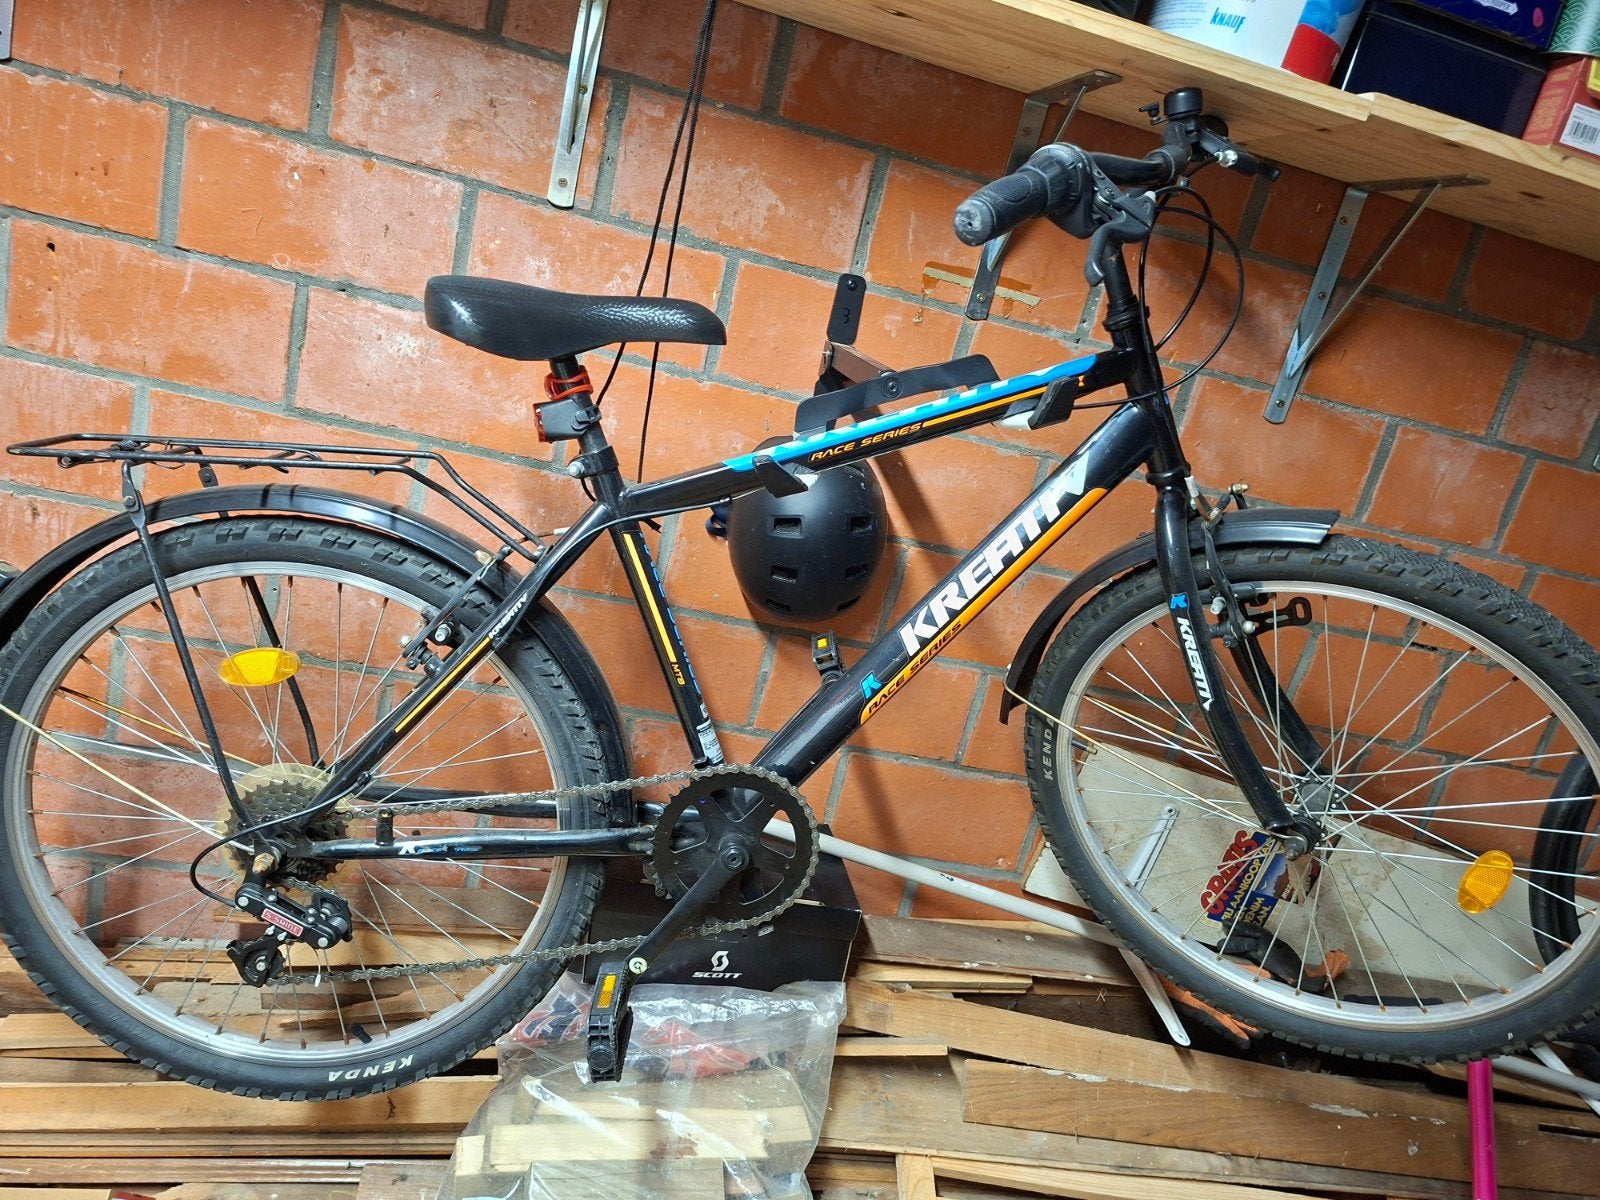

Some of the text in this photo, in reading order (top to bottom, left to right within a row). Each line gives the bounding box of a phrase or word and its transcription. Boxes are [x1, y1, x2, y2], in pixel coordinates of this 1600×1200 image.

[1210, 7, 1246, 33] KNAUF
[810, 422, 922, 462] RACE SERIES
[899, 449, 1090, 657] KREATIV
[868, 620, 962, 715] RACE SERIES
[1176, 616, 1215, 712] KREATIV
[1199, 829, 1258, 915] GRATIS
[1230, 858, 1261, 908] AANKOOP
[691, 971, 743, 980] SCOTT
[328, 1054, 414, 1083] KENDA
